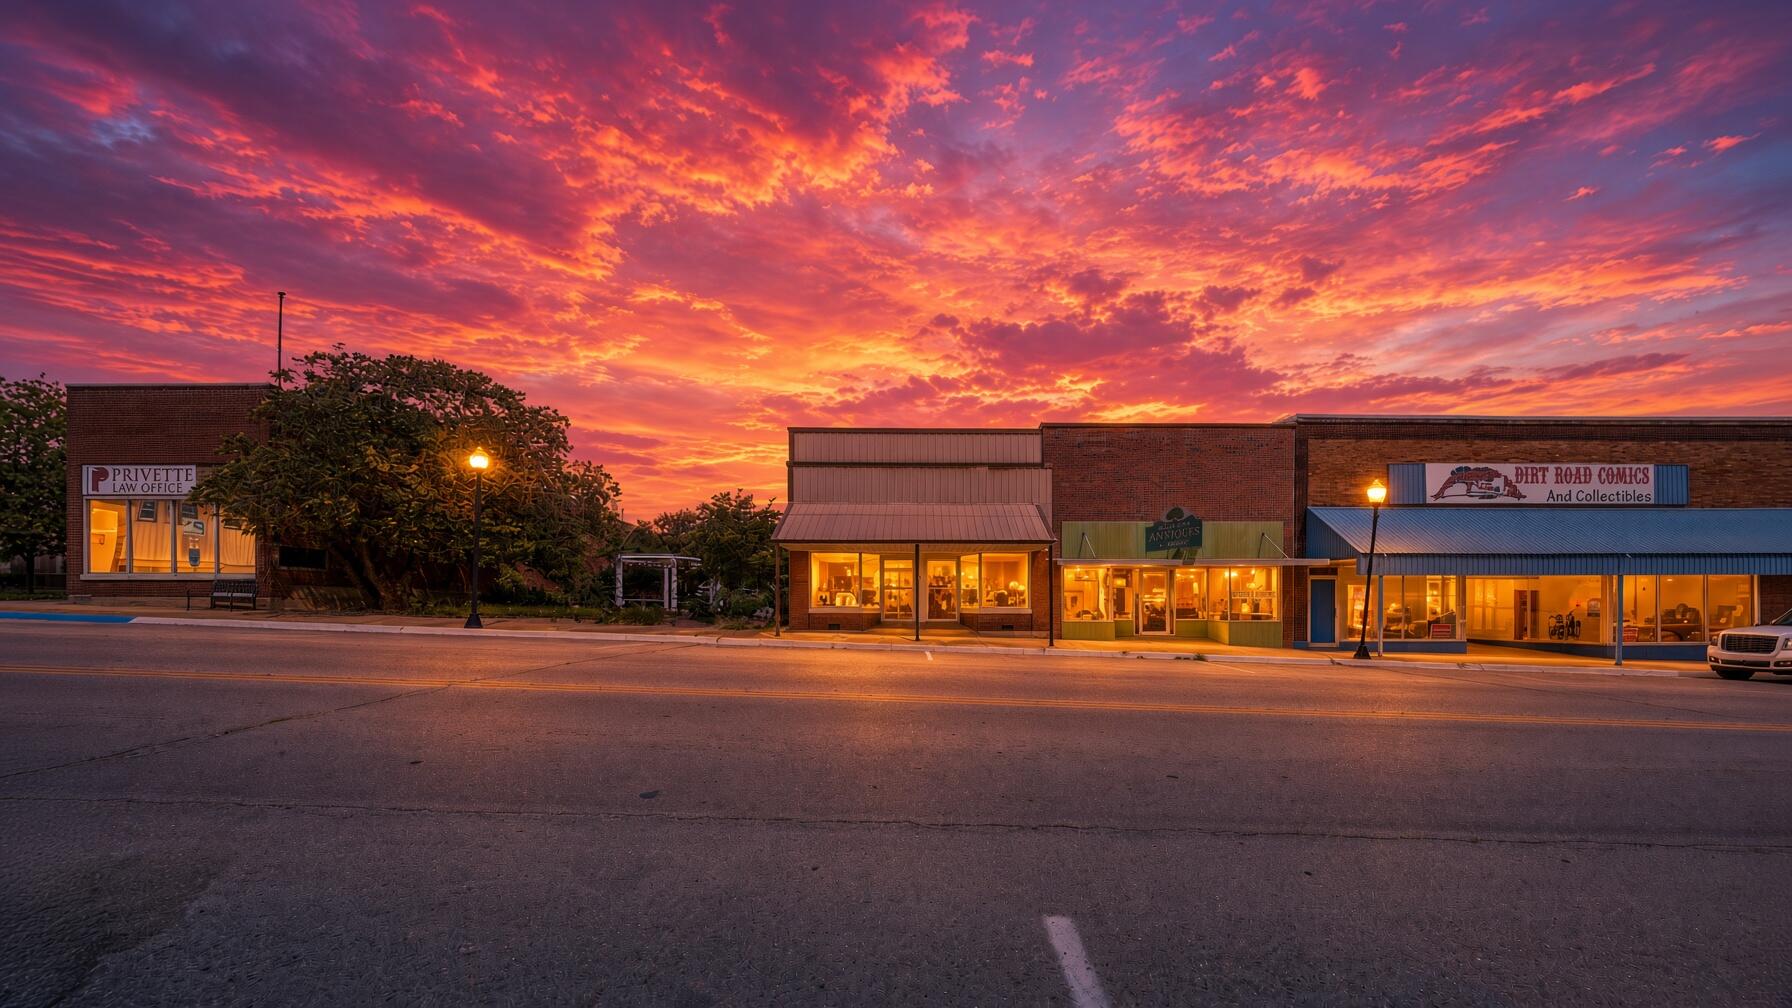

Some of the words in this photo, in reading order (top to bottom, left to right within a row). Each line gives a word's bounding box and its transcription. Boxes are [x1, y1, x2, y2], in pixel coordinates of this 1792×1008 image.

[112, 468, 194, 482] PRIVETTE
[1514, 466, 1549, 485] DIRT
[1554, 466, 1592, 485] ROAD
[1598, 466, 1650, 485] COMICS
[112, 482, 138, 493] LAW
[141, 482, 183, 493] OFFICE
[1546, 489, 1572, 503] And
[1576, 489, 1652, 503] Collectibles
